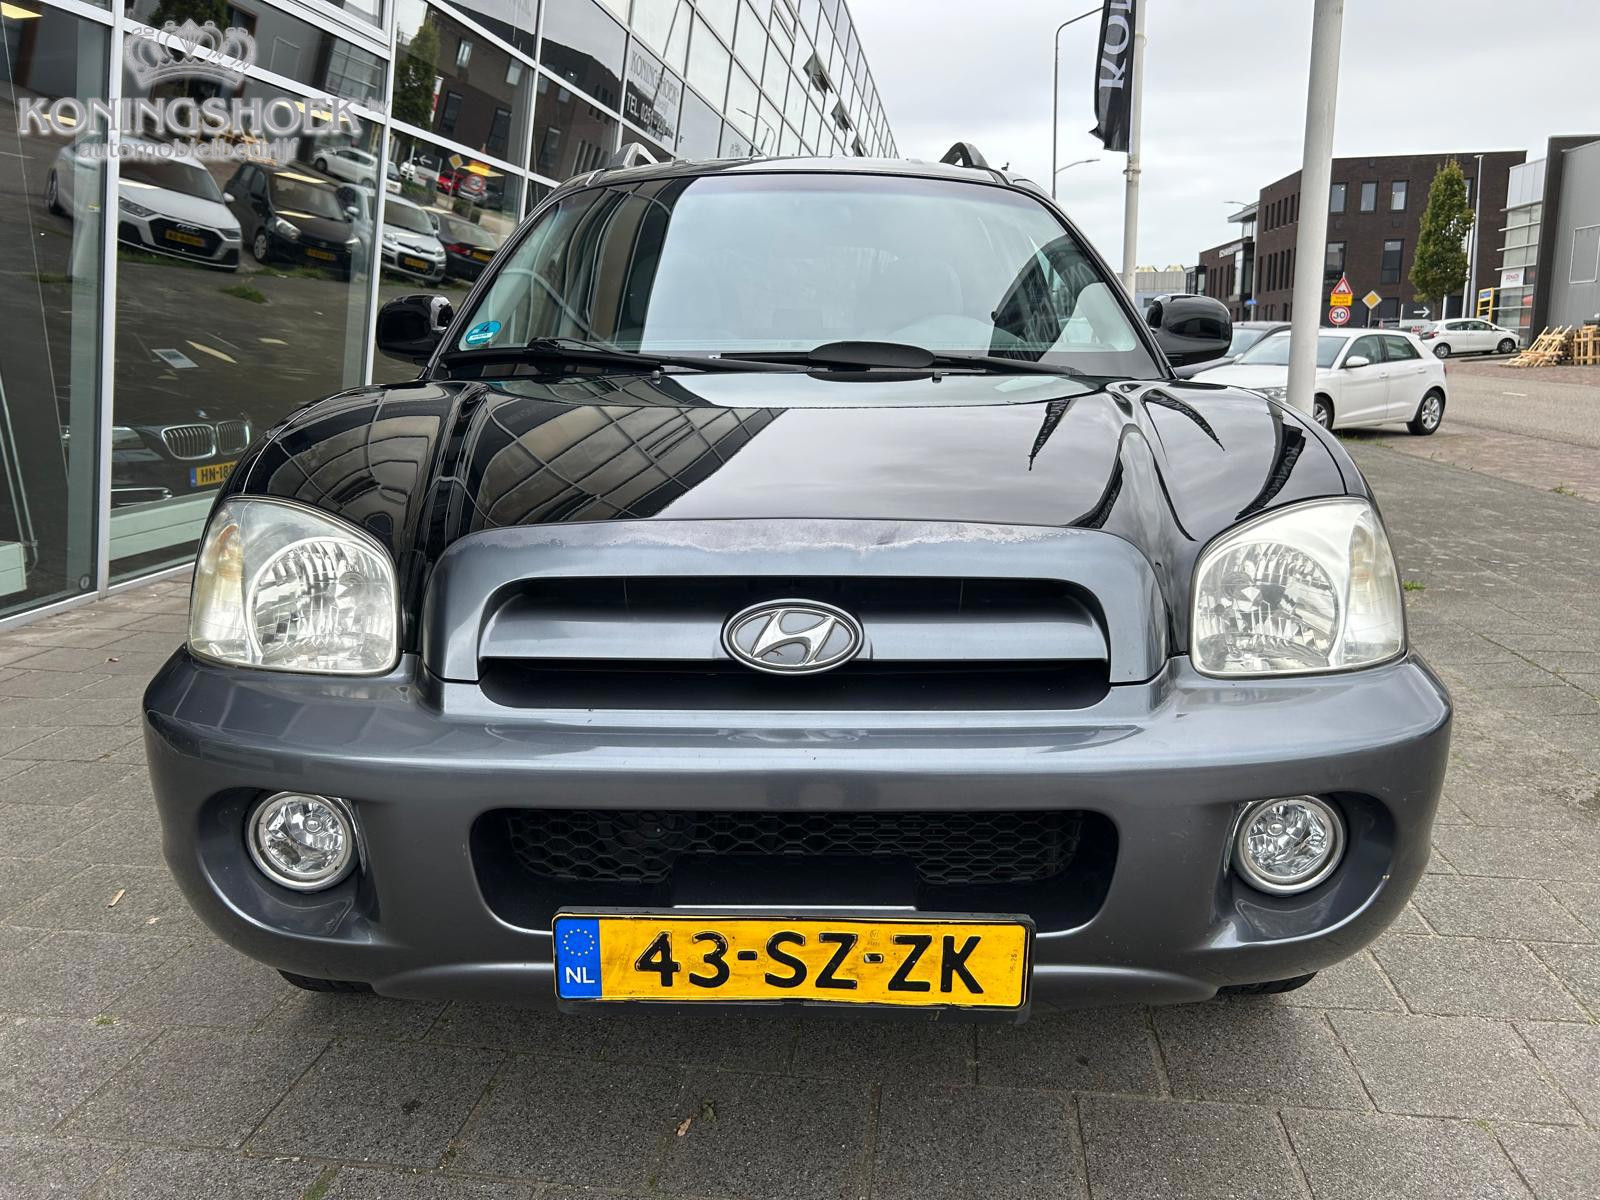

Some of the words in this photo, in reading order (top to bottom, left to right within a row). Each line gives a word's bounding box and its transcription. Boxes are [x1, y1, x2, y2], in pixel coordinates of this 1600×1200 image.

[1333, 311, 1346, 320] 30
[634, 930, 985, 995] 43-SZ-ZK
[565, 966, 596, 984] NL
